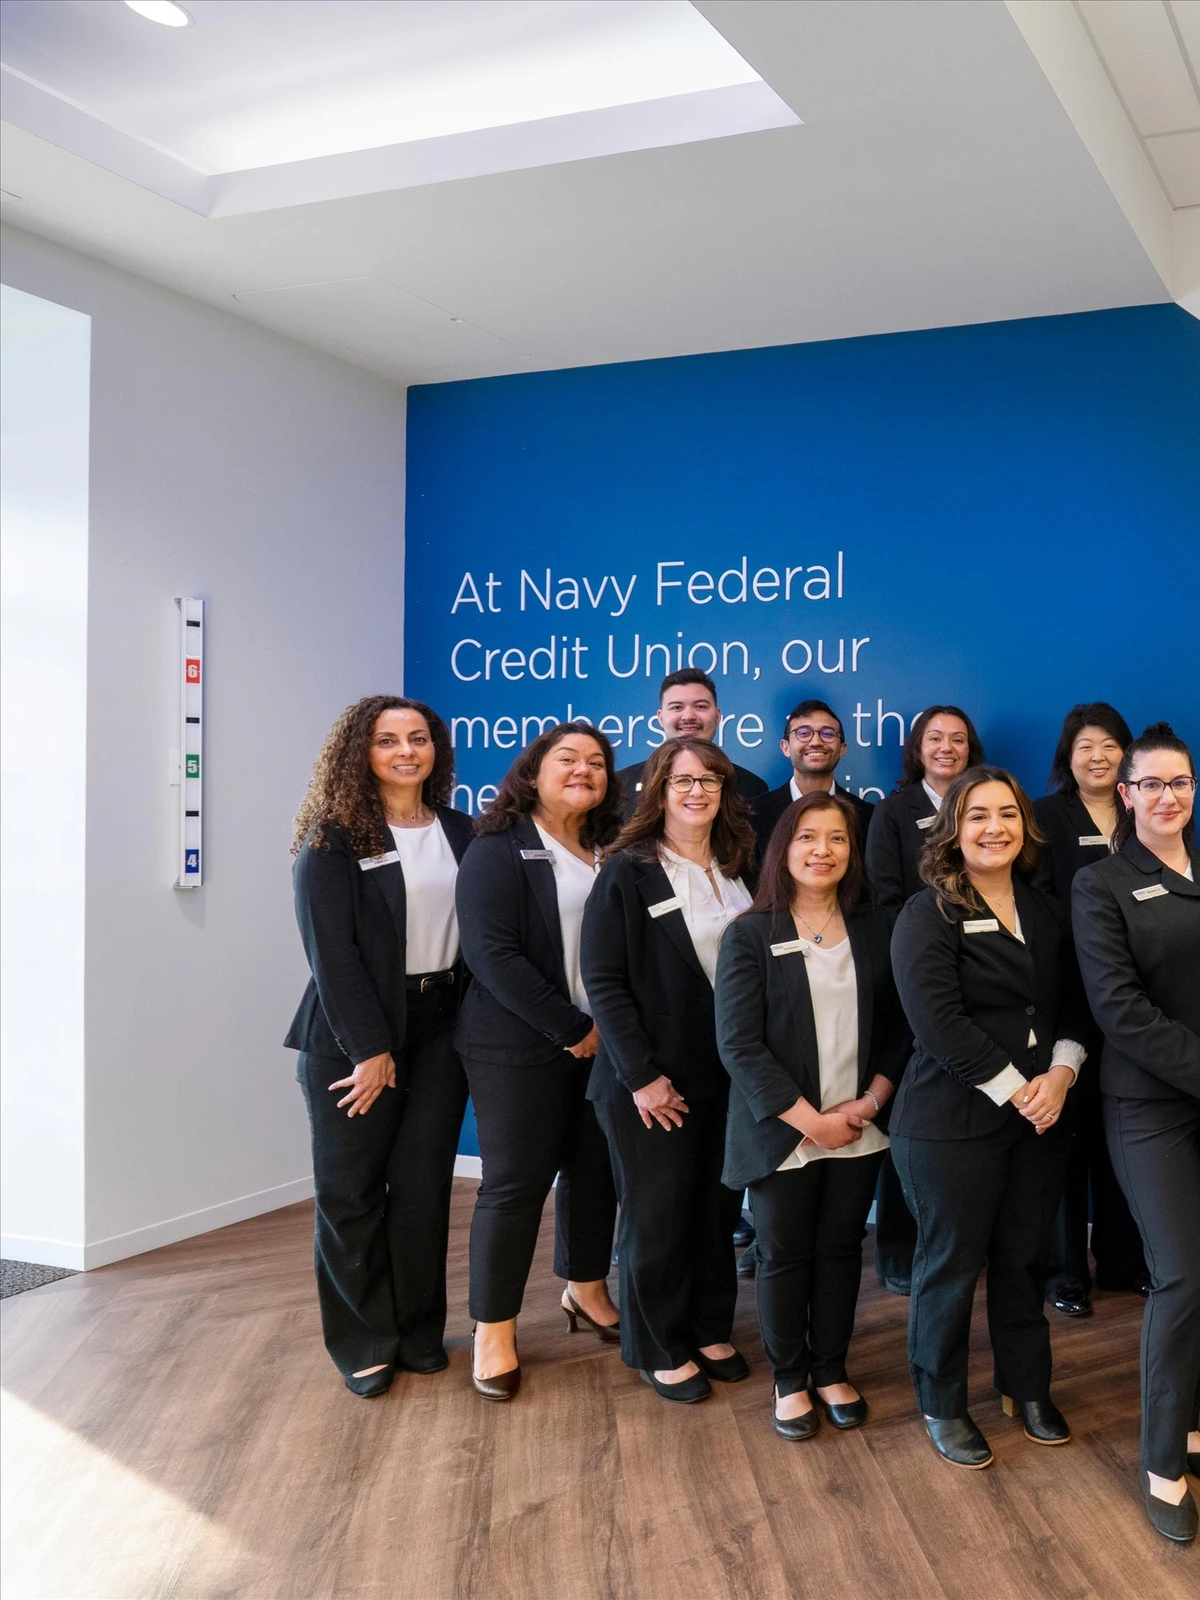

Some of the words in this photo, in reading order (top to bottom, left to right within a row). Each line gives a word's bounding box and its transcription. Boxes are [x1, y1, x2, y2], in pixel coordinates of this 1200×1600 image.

[450, 572, 502, 614] At
[520, 568, 637, 617] Navy
[657, 551, 844, 606] Federal
[187, 664, 198, 678] 6
[451, 634, 589, 682] Credit
[608, 632, 761, 681] Union,
[781, 637, 870, 674] our
[718, 713, 764, 748] re
[853, 699, 925, 747] th
[187, 760, 198, 773] 5
[187, 854, 197, 867] 4
